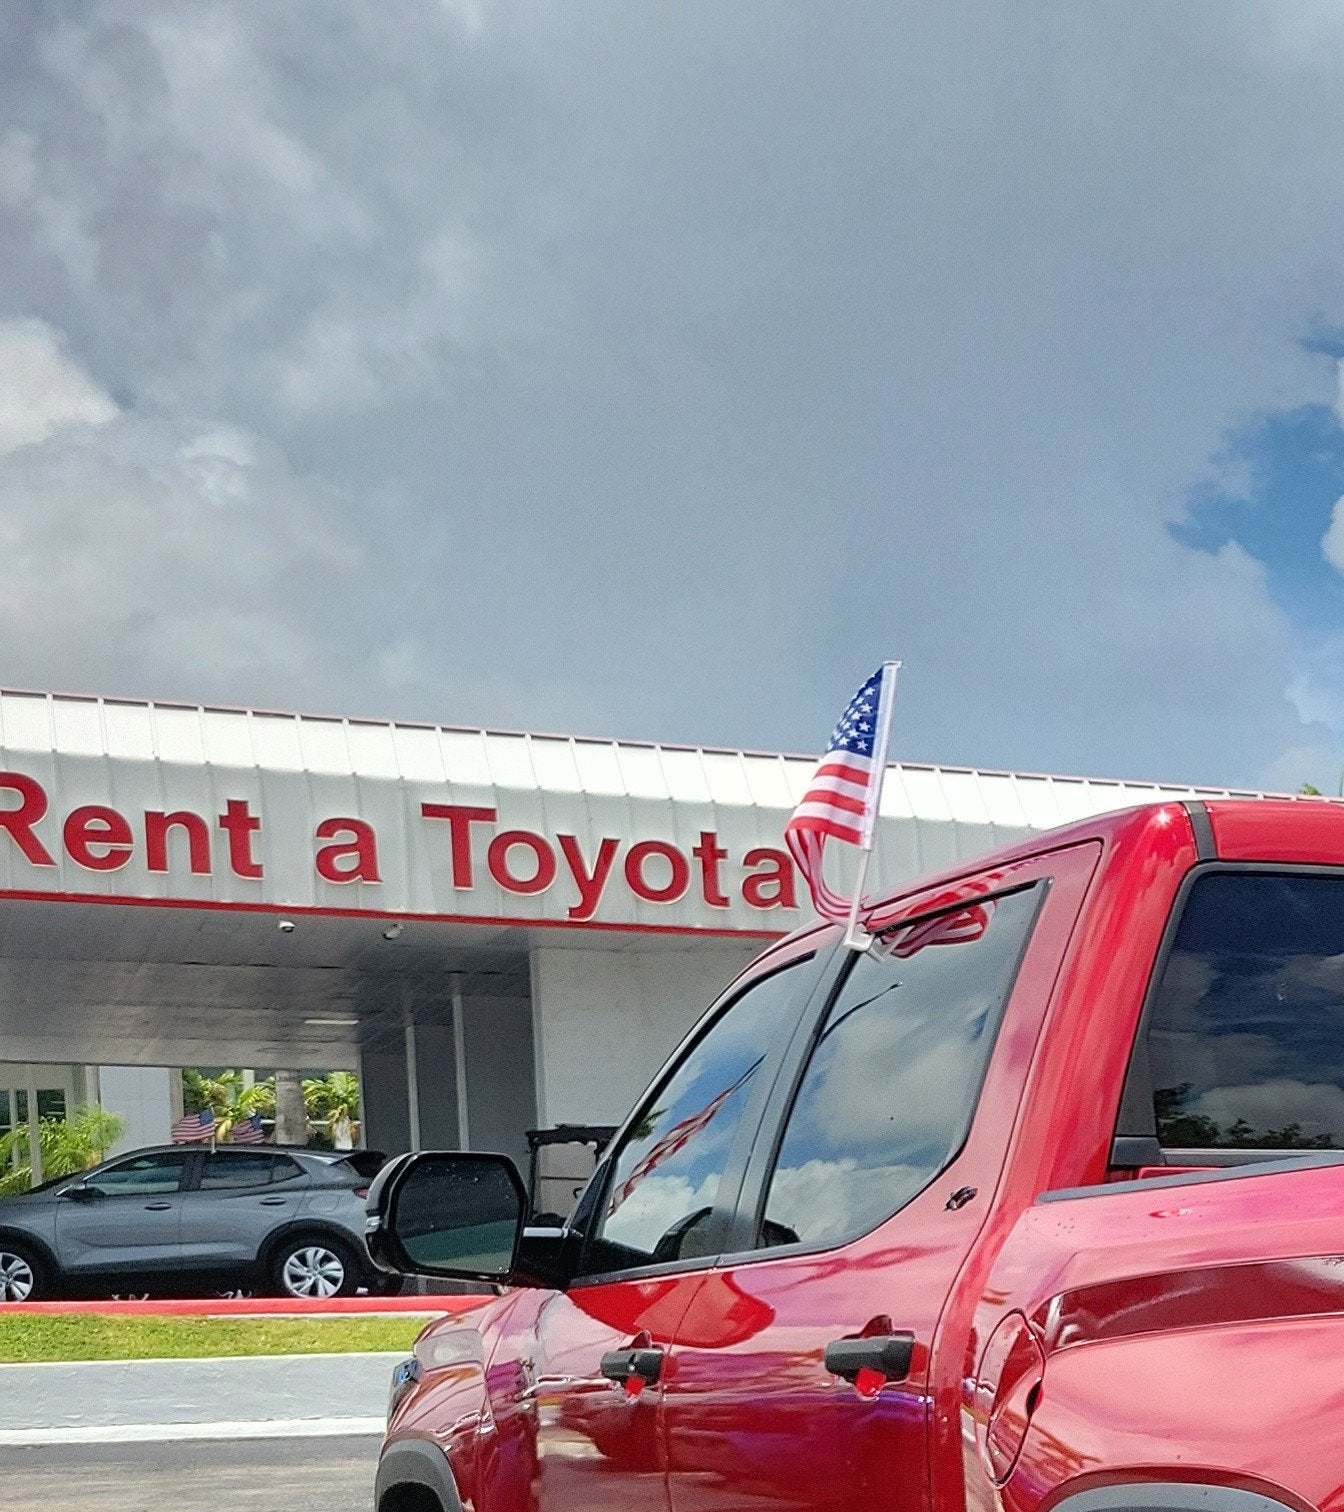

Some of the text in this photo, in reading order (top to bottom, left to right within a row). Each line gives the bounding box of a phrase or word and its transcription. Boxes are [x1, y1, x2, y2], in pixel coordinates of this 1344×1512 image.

[0, 771, 800, 922] Rent a Toyota
